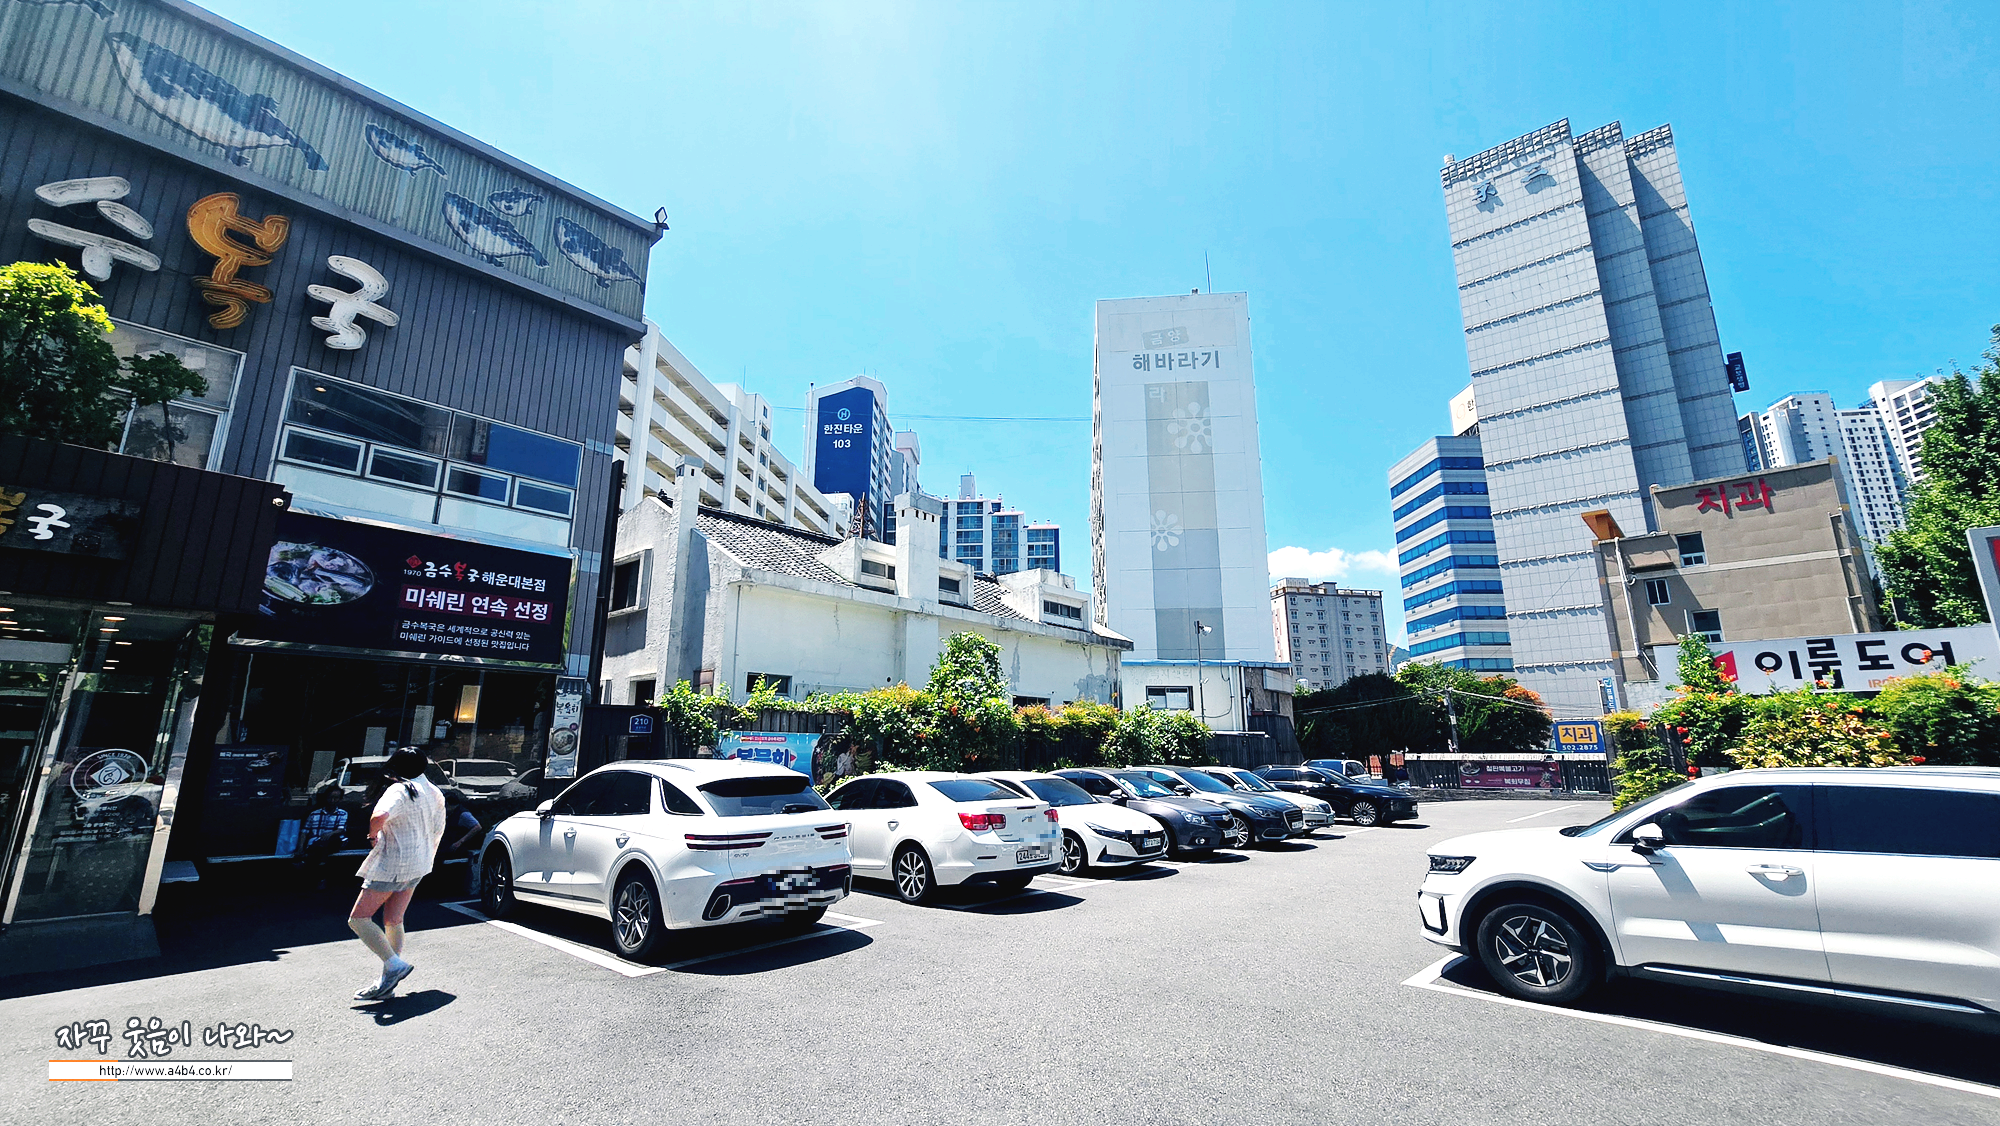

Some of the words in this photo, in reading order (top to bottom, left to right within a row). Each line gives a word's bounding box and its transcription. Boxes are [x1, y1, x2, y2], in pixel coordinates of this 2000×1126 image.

[1132, 350, 1220, 372] 해바라기
[823, 423, 863, 435] 한진타운
[833, 439, 851, 449] 103
[1695, 478, 1773, 515] 치과
[403, 568, 422, 577] 1970
[423, 561, 480, 583] 금수복국
[481, 571, 547, 593] 해운대본점
[405, 587, 465, 612] 미쉐린
[471, 596, 509, 617] 연속
[513, 601, 548, 621] 선정
[401, 620, 446, 633] 금수복국은
[447, 625, 489, 636] 세계적으로
[490, 628, 514, 639] 공신력
[515, 631, 531, 640] 있는
[399, 632, 426, 643] 미쉐린
[428, 635, 463, 646] 가이드에
[464, 638, 489, 647] 선정된
[490, 640, 530, 652] 맛집입니다
[634, 717, 649, 726] 210
[1561, 726, 1594, 742] 치과
